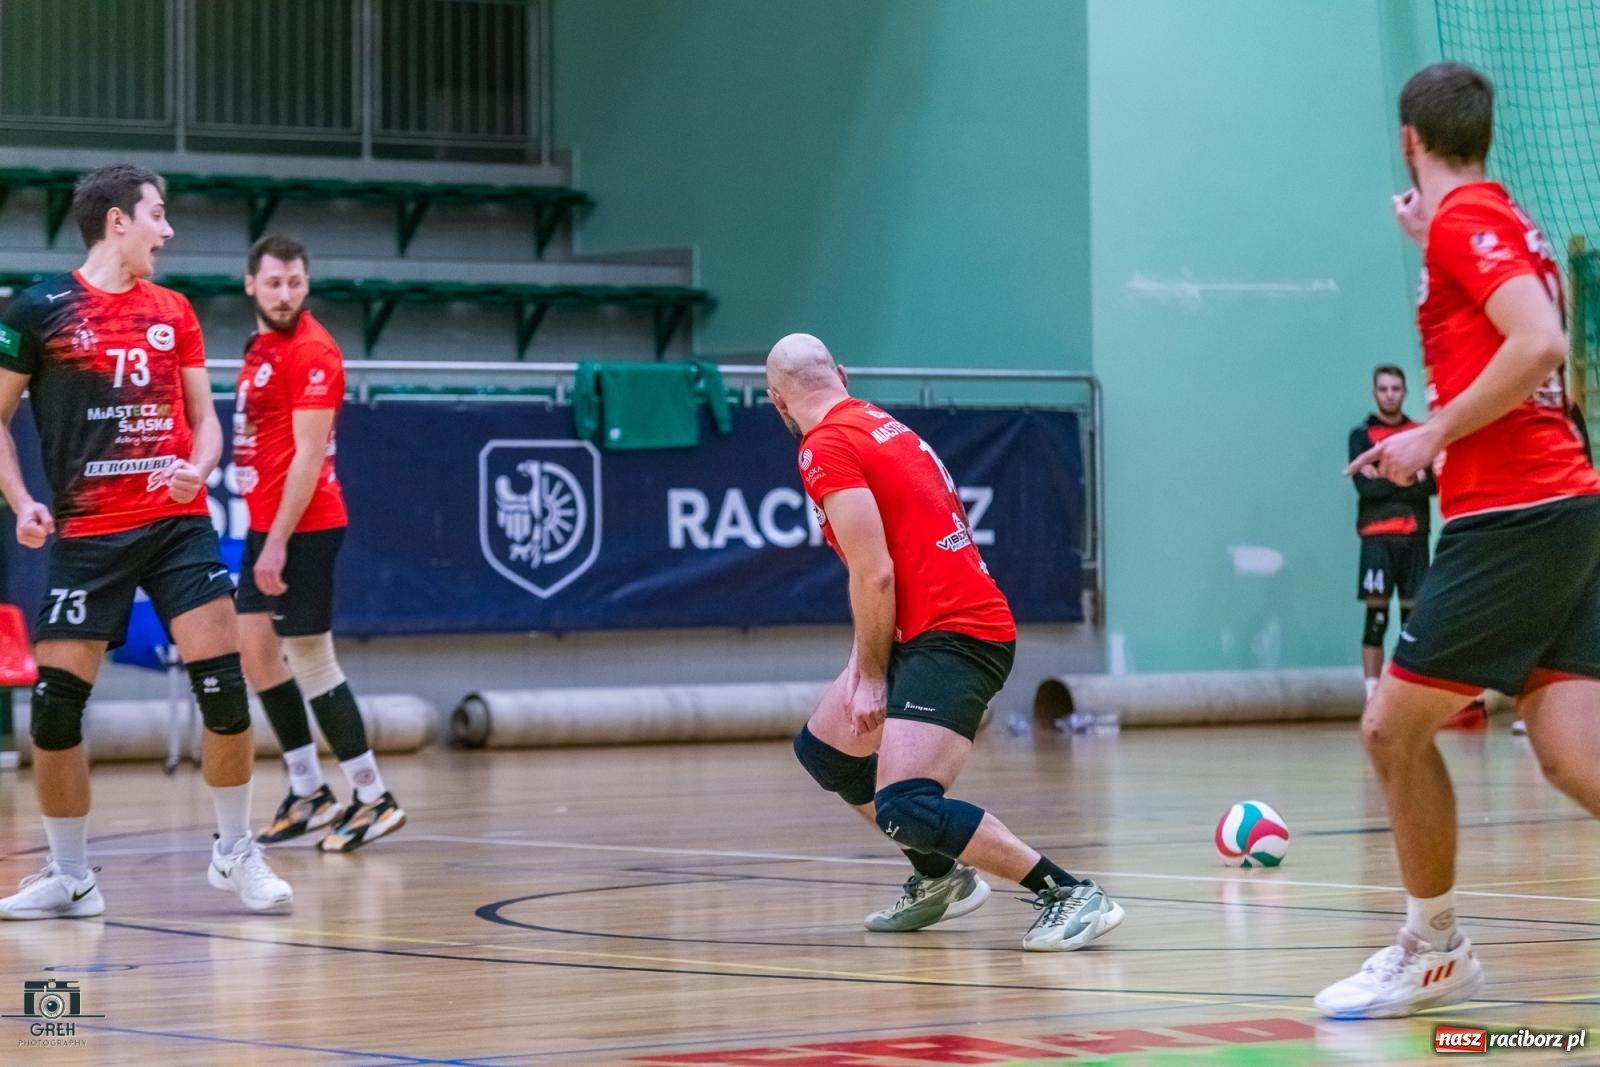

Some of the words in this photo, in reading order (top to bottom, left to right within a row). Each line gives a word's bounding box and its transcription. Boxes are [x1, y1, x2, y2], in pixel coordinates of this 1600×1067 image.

[106, 347, 151, 388] 73
[1363, 568, 1385, 593] 44
[49, 588, 88, 624] 73
